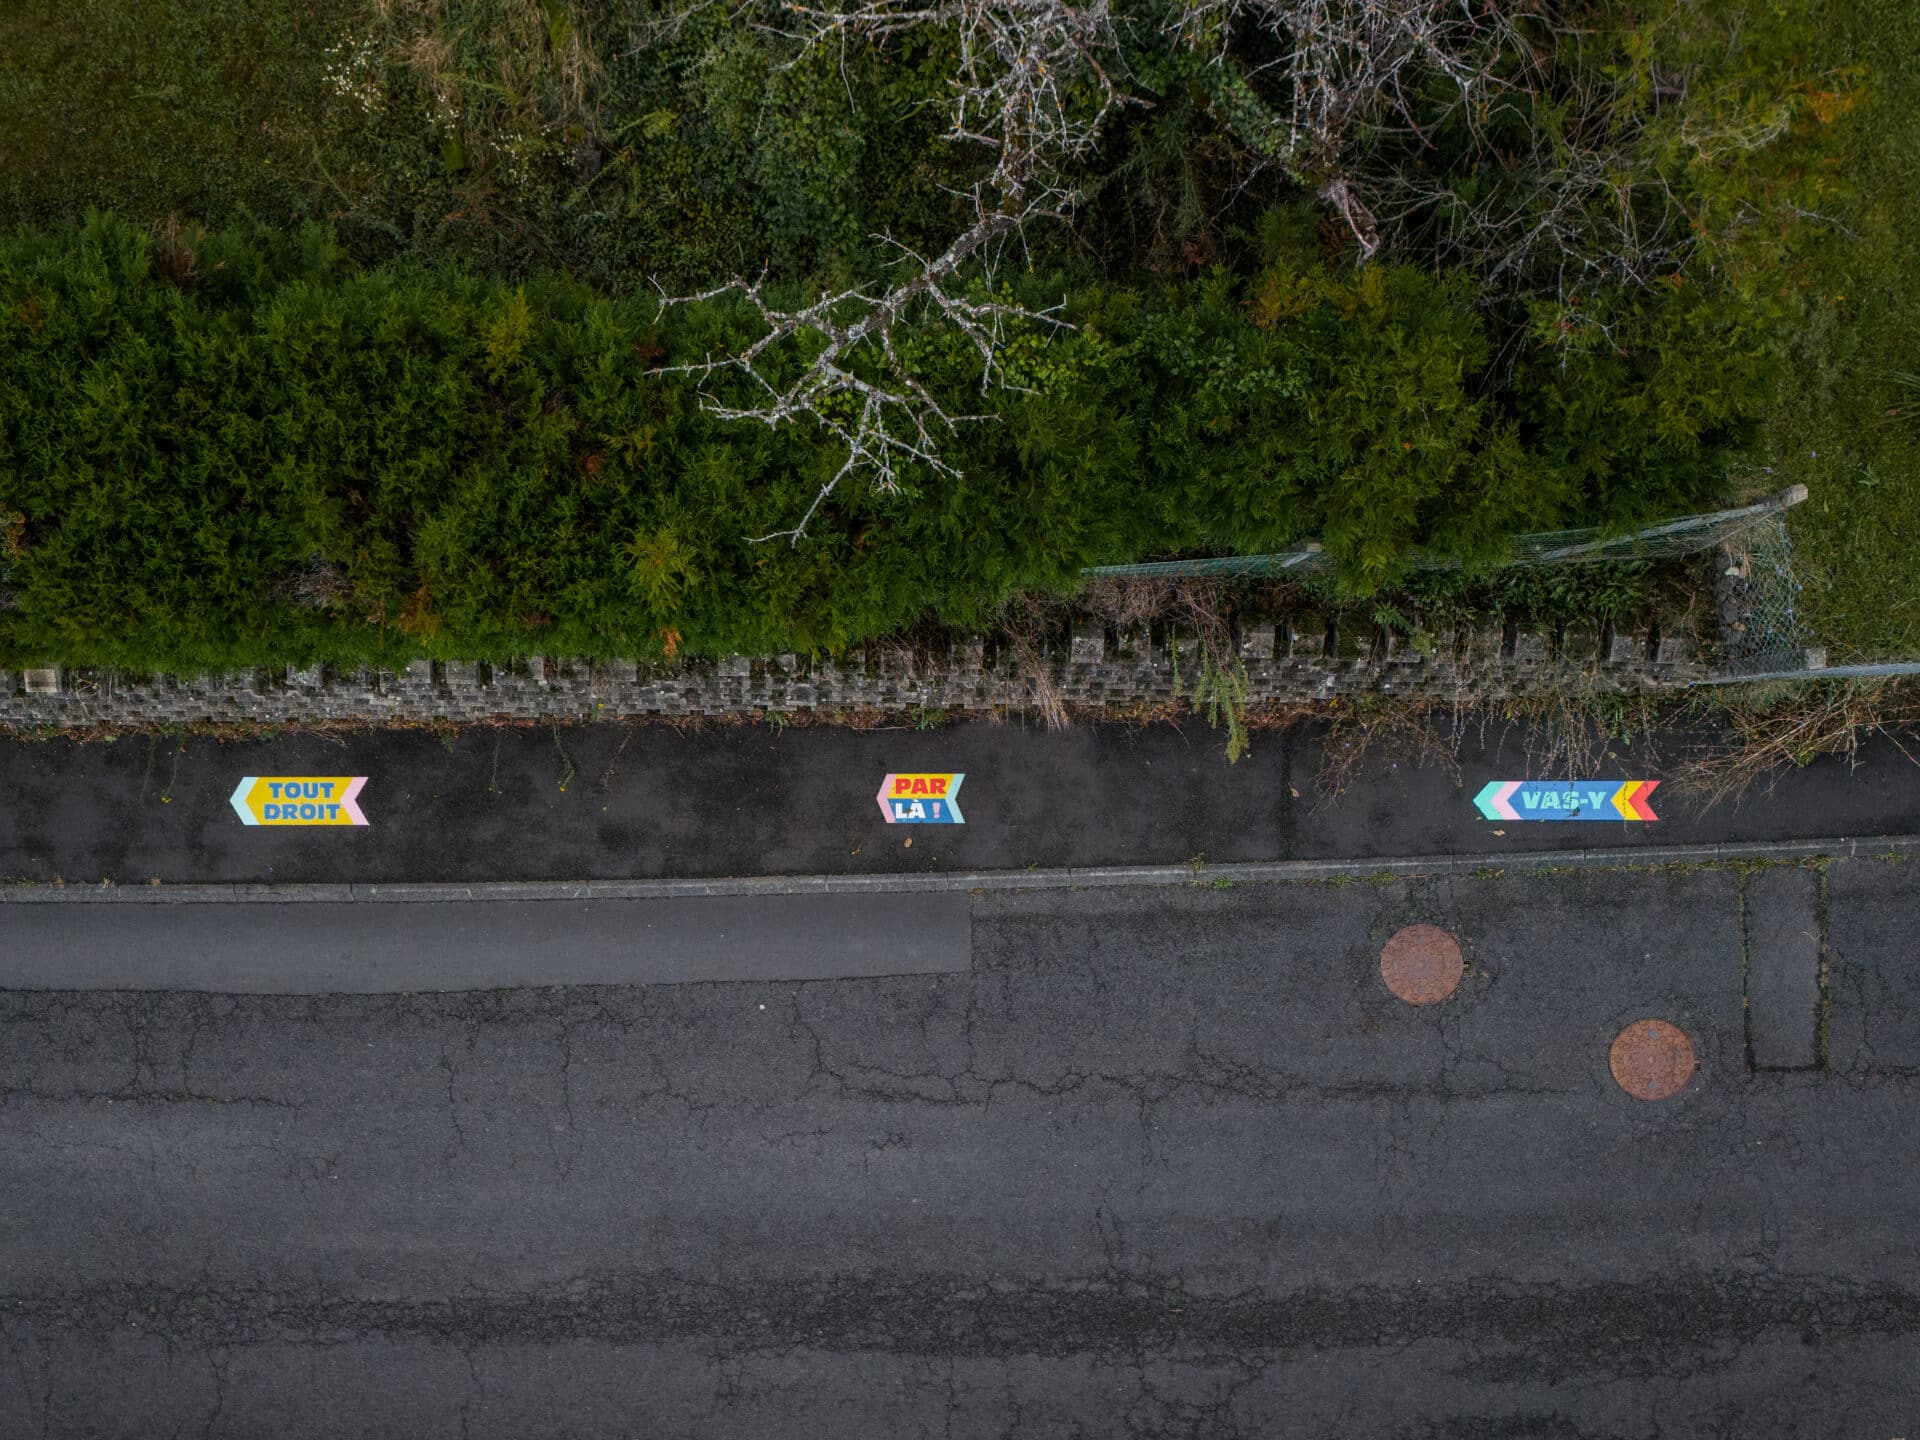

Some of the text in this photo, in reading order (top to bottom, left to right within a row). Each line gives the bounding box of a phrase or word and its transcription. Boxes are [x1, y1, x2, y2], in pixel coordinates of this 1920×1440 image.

[267, 782, 335, 799] TOUT
[895, 778, 946, 794] PAR
[895, 798, 926, 819] LÀ
[1521, 791, 1607, 810] VAS-Y
[264, 803, 340, 820] DROIT
